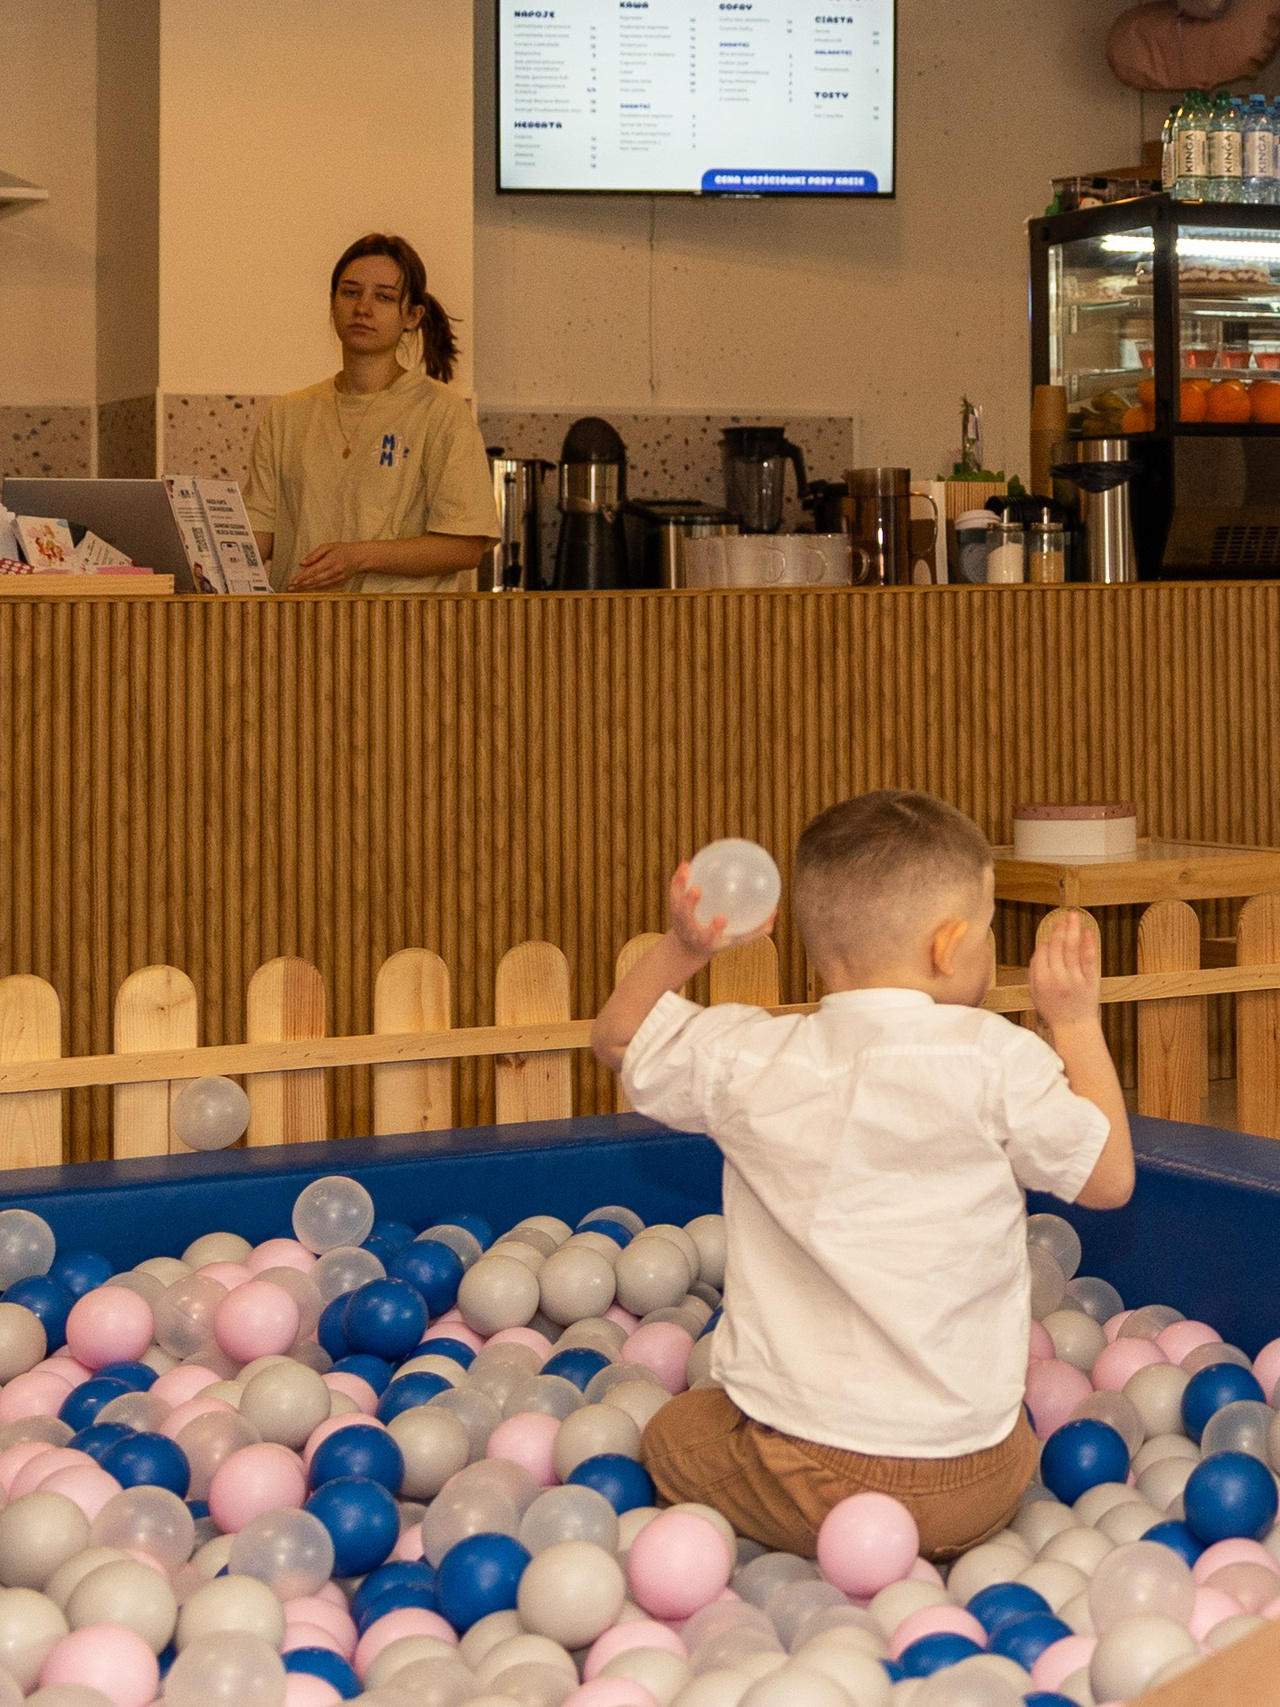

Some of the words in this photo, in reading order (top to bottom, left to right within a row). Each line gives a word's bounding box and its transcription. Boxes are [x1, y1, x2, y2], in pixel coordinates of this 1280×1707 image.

[619, 1, 649, 9] KAWA
[719, 3, 753, 11] GOFRY
[514, 10, 555, 18] NAPOJE
[815, 16, 854, 24] CIASTA
[514, 121, 563, 129] HERBATA
[1184, 133, 1195, 173] KINGA
[1224, 134, 1233, 173] KINGA
[1258, 134, 1267, 174] KINGA
[714, 174, 741, 185] CENA
